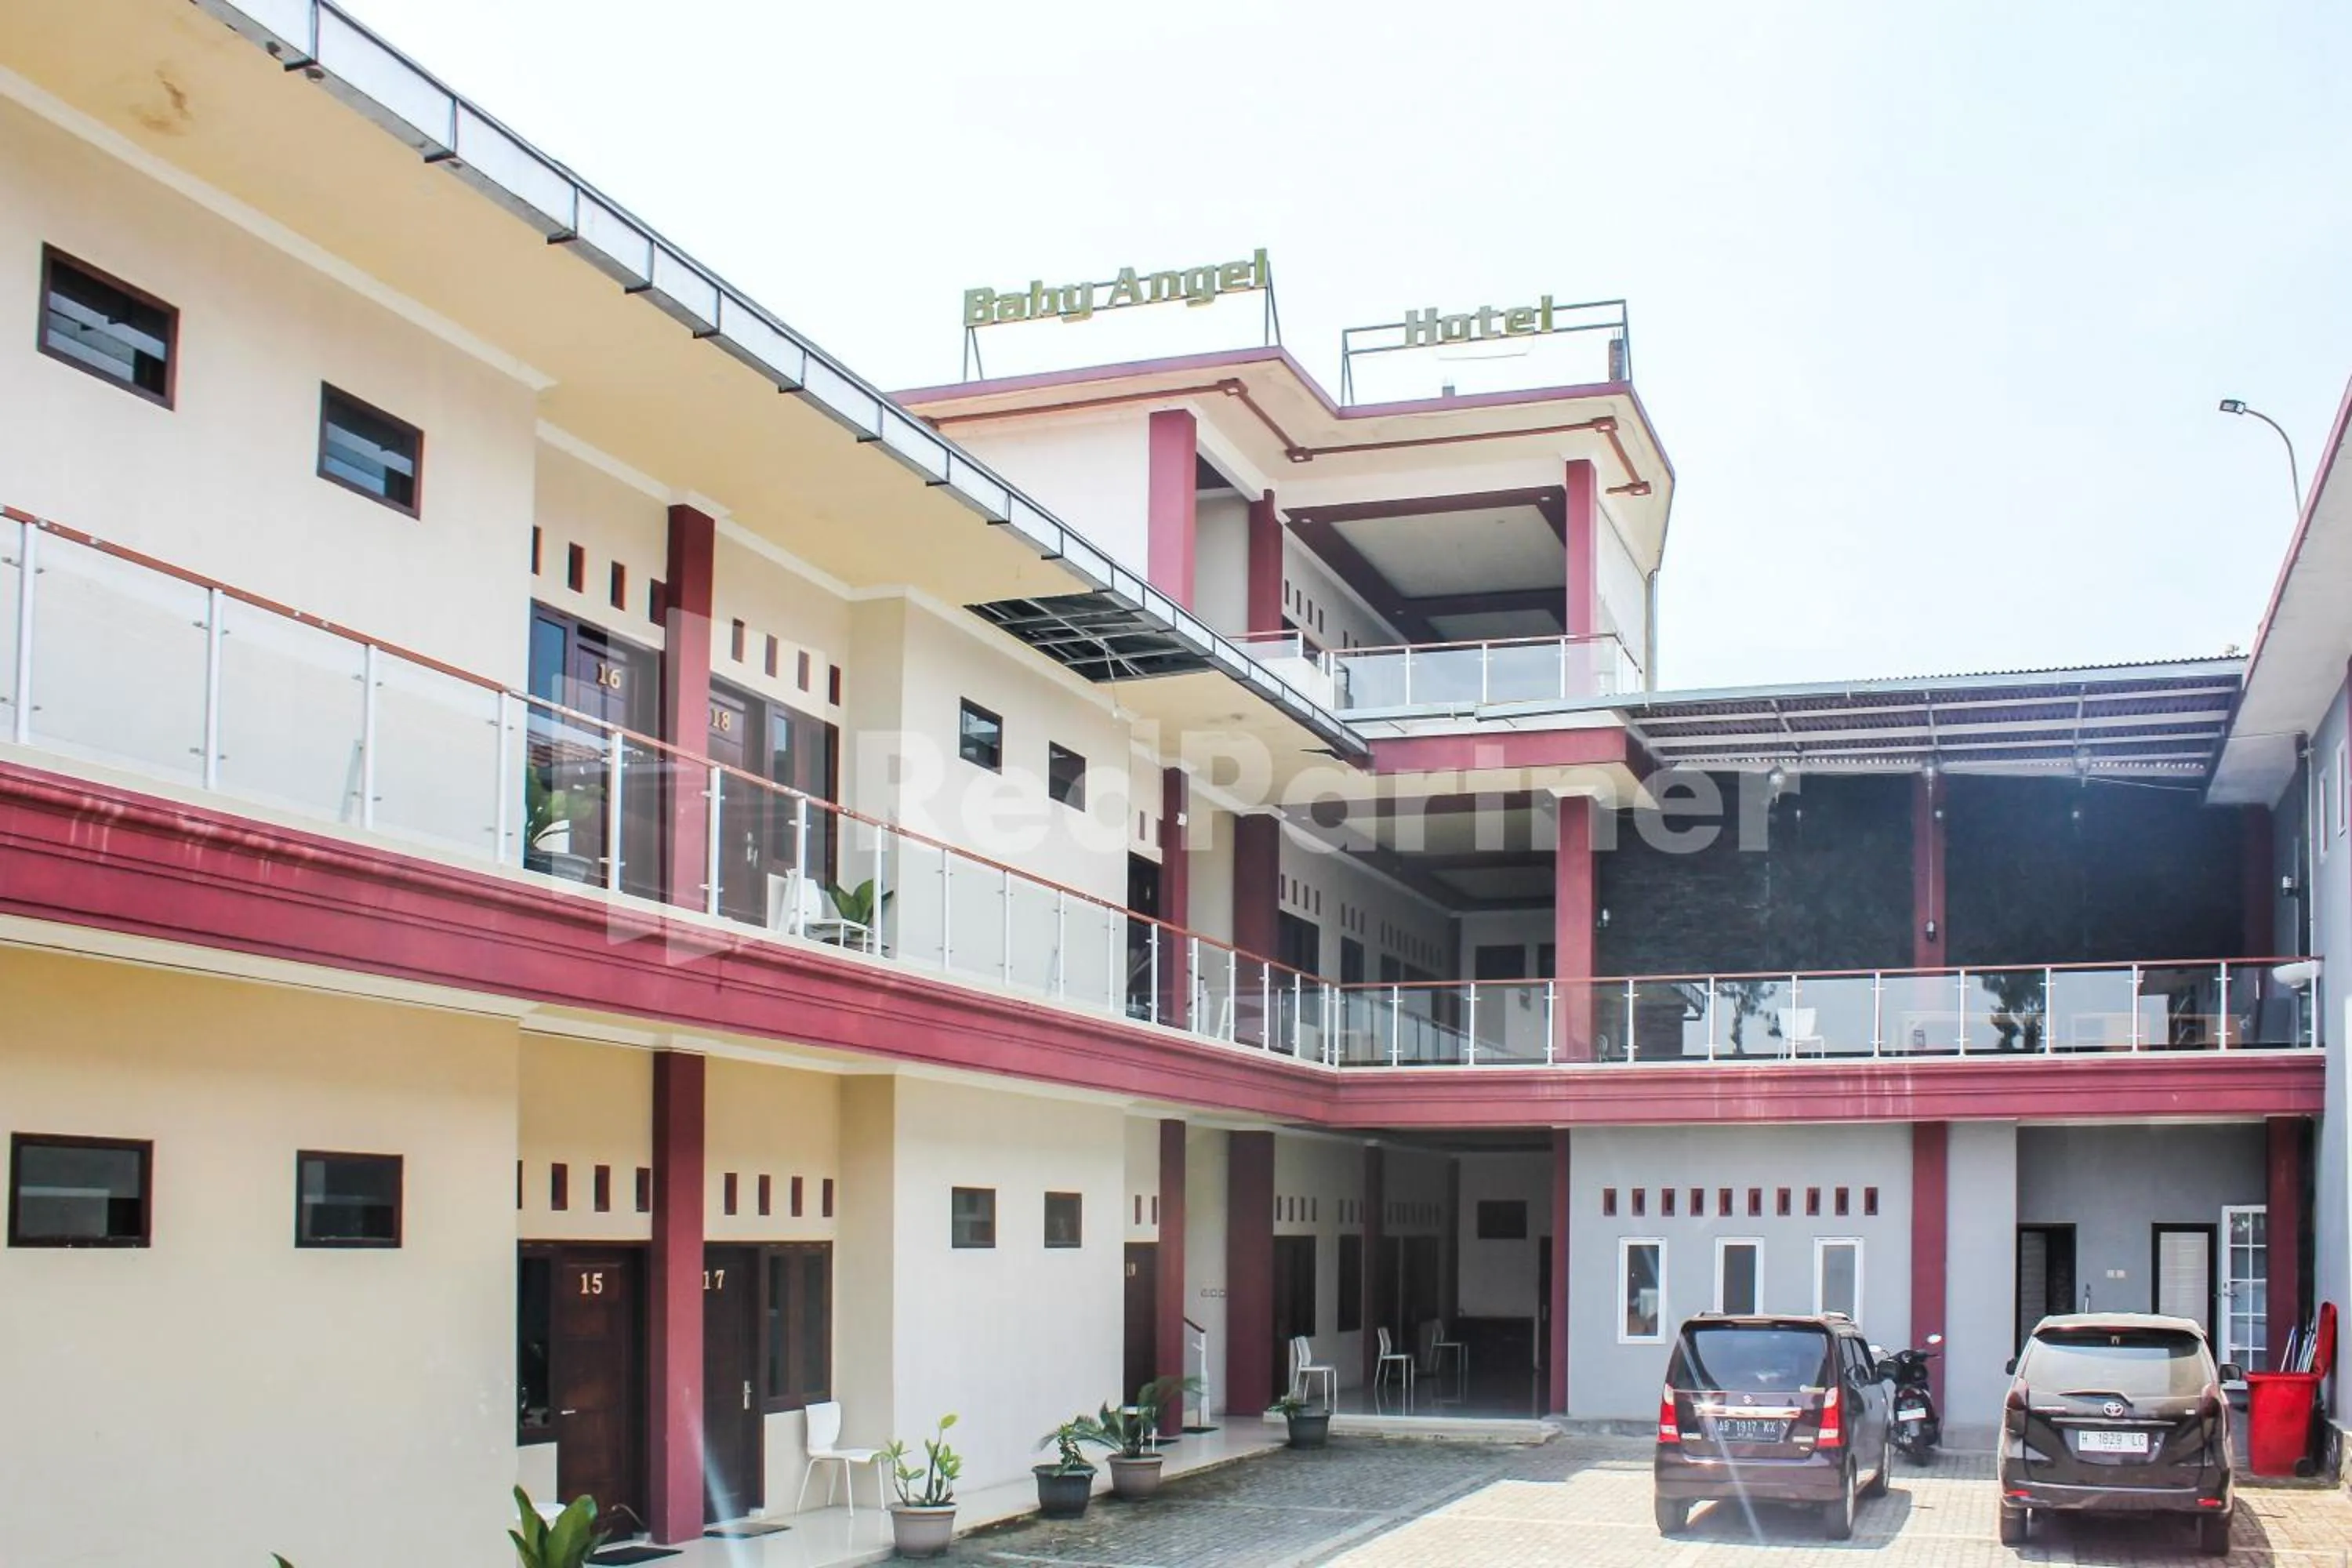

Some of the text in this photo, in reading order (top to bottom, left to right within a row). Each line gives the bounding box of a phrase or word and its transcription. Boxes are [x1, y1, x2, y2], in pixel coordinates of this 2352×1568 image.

[964, 248, 1268, 327] Baby Angel
[1405, 295, 1553, 347] Hotel
[597, 662, 622, 690] 16
[710, 708, 731, 731] 18
[580, 1272, 603, 1294] 15
[702, 1269, 725, 1290] 17
